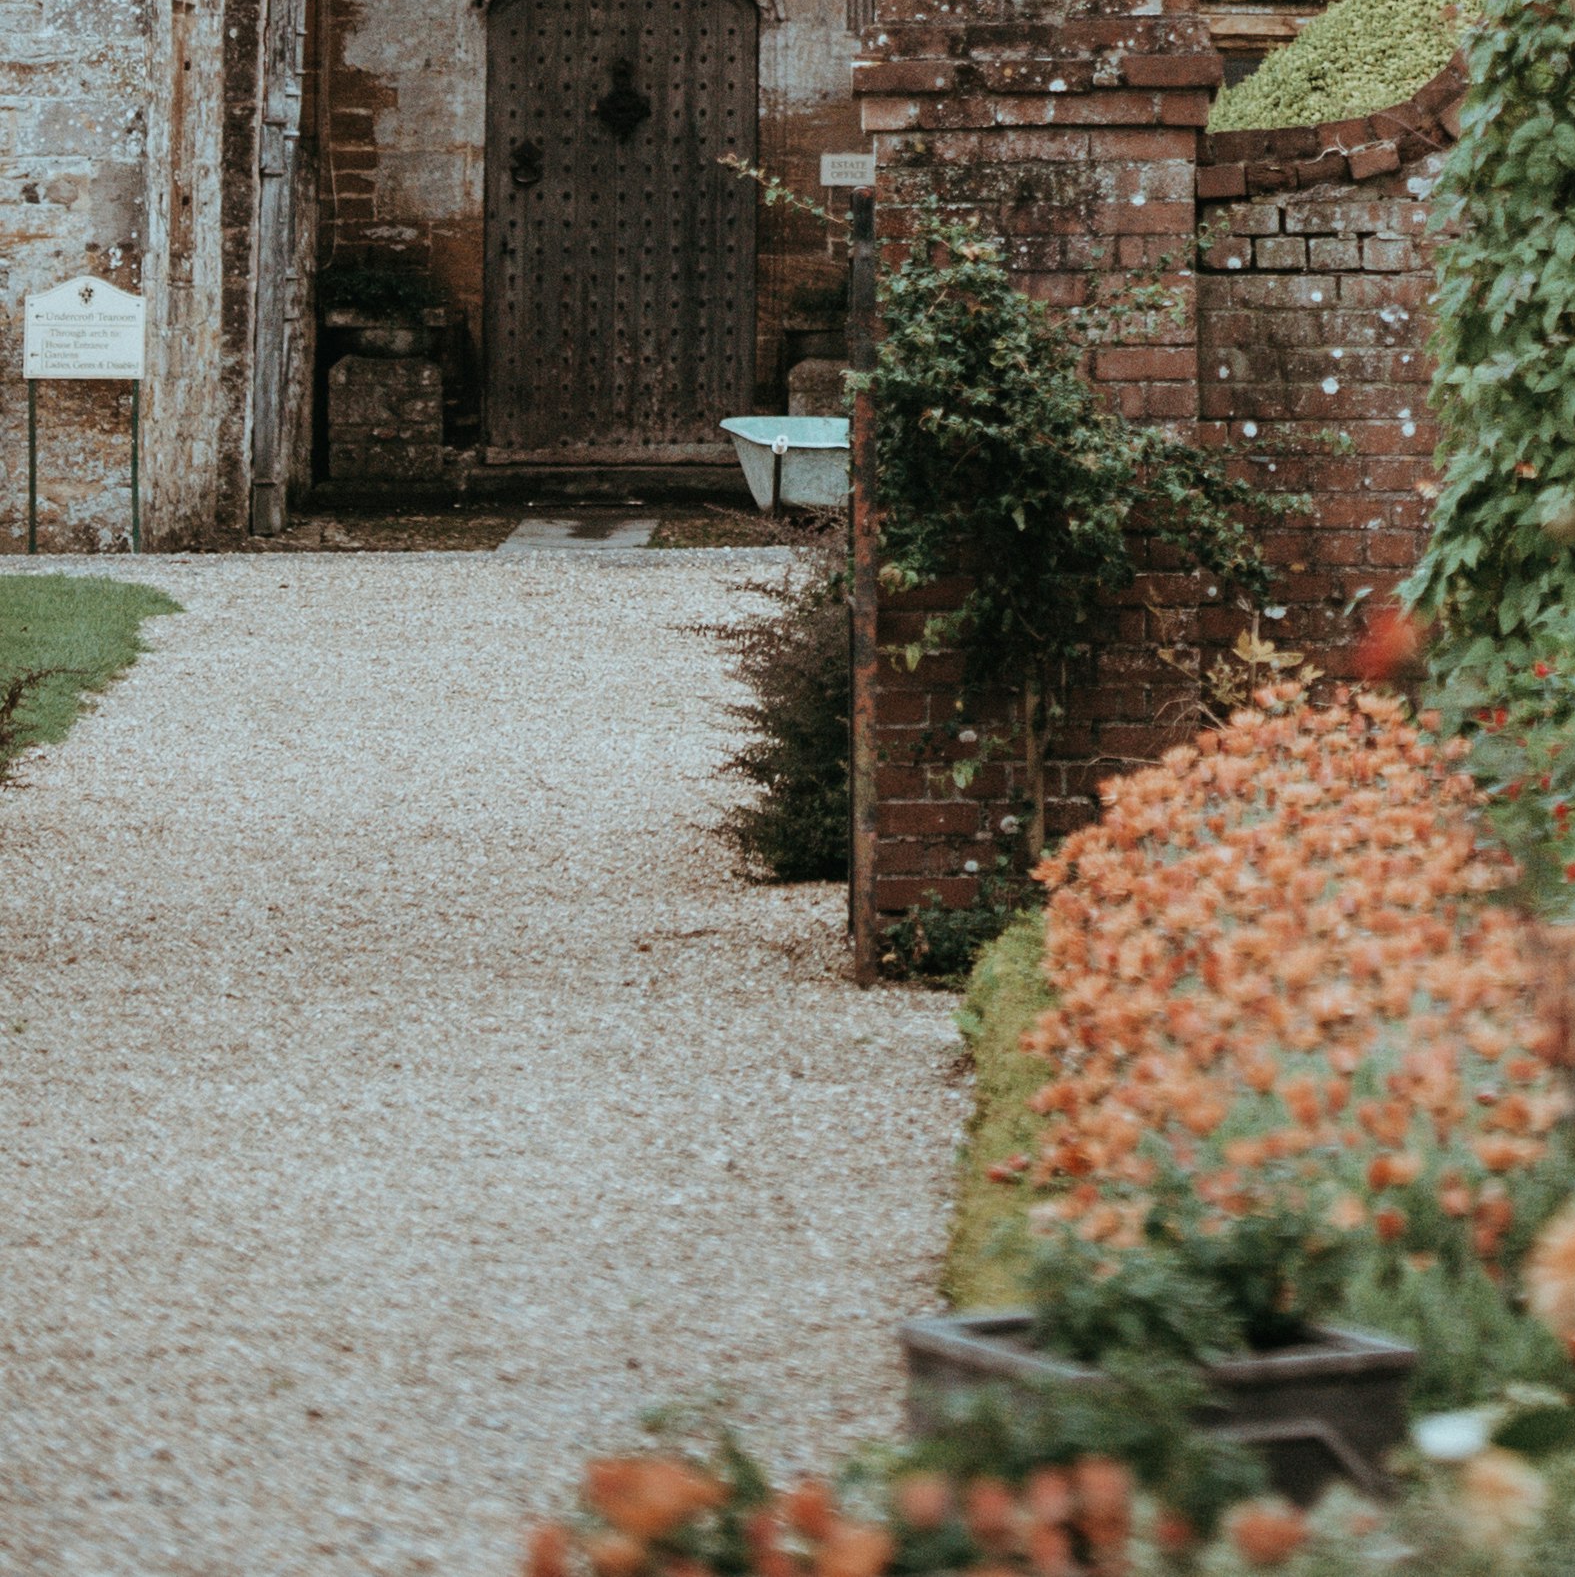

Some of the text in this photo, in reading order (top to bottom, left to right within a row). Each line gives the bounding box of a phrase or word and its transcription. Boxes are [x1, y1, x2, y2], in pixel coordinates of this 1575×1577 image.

[831, 160, 867, 169] ESTATE
[830, 171, 867, 180] OFFICE
[45, 312, 137, 321] Undercroft Tearoom
[50, 328, 86, 338] Through
[89, 329, 108, 338] arch
[45, 340, 109, 349] House Entrance
[44, 350, 79, 359] Gardens
[72, 360, 96, 369] Gents
[106, 360, 139, 369] Disabled
